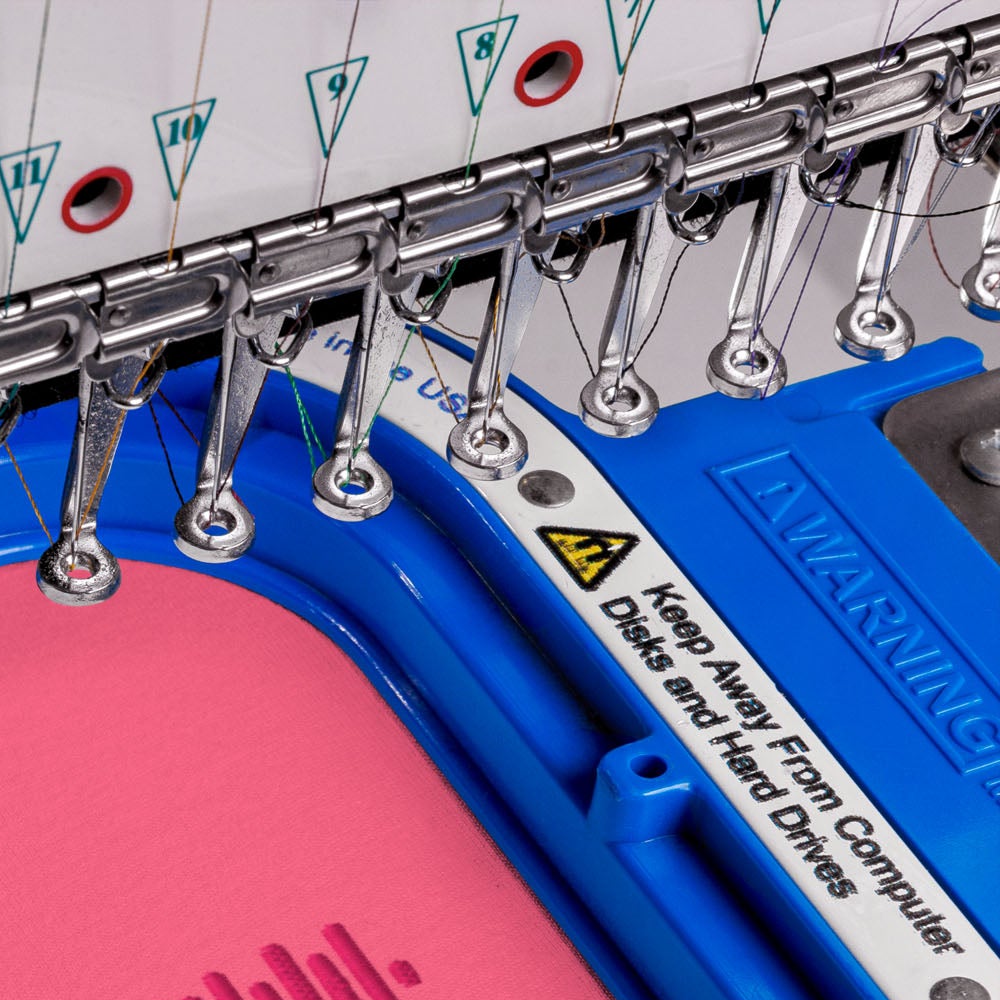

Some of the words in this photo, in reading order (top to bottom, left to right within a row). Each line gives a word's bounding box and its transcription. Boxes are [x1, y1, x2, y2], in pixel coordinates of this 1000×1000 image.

[474, 32, 496, 60] 8
[327, 73, 348, 101] 9
[166, 113, 204, 147] 10
[10, 156, 44, 189] 11
[417, 377, 468, 419] US
[781, 511, 1000, 754] WARNING
[599, 595, 675, 673] Disks
[662, 676, 732, 730] and
[708, 730, 790, 803] Hard
[767, 804, 858, 899] Drives
[641, 582, 716, 655] Keep
[699, 660, 782, 731] Away
[766, 734, 843, 813] From
[834, 814, 966, 955] Computer
